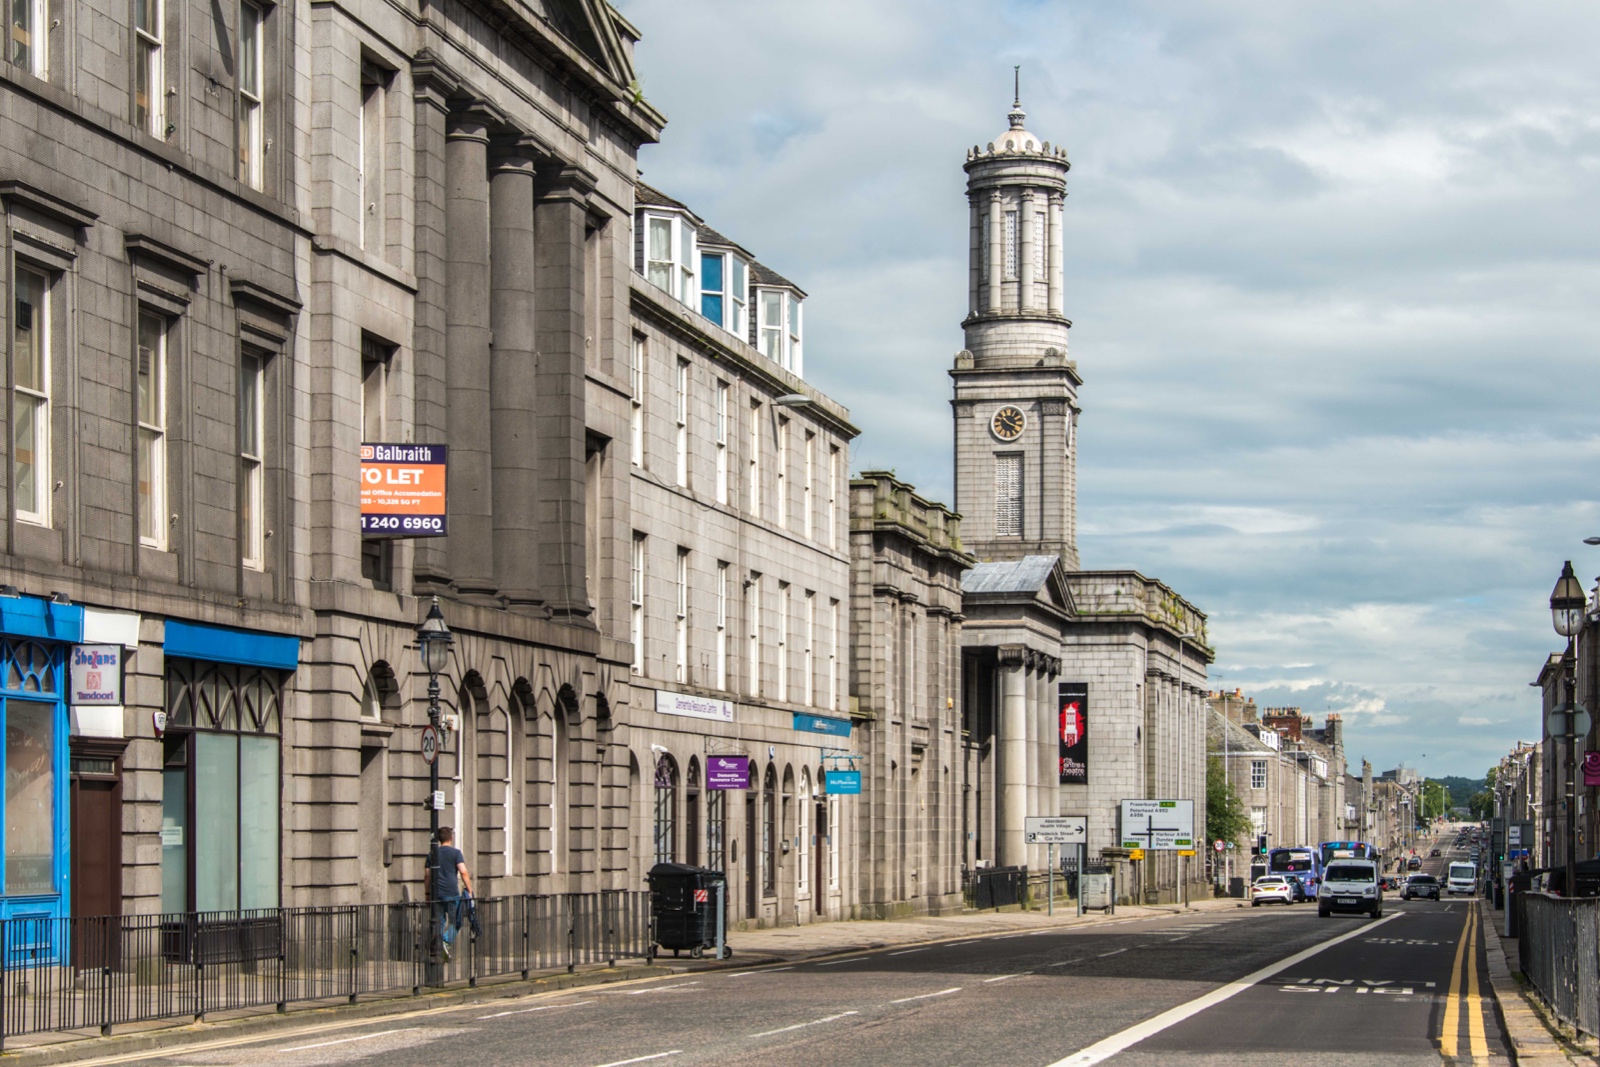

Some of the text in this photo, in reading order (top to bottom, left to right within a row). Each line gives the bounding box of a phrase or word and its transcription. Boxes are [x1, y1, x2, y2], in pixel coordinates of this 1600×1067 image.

[376, 446, 431, 461] Galbraith
[386, 469, 424, 485] LET
[370, 517, 400, 529] 240
[403, 518, 442, 530] 6960
[77, 691, 114, 700] Tandoori
[423, 736, 435, 753] 20
